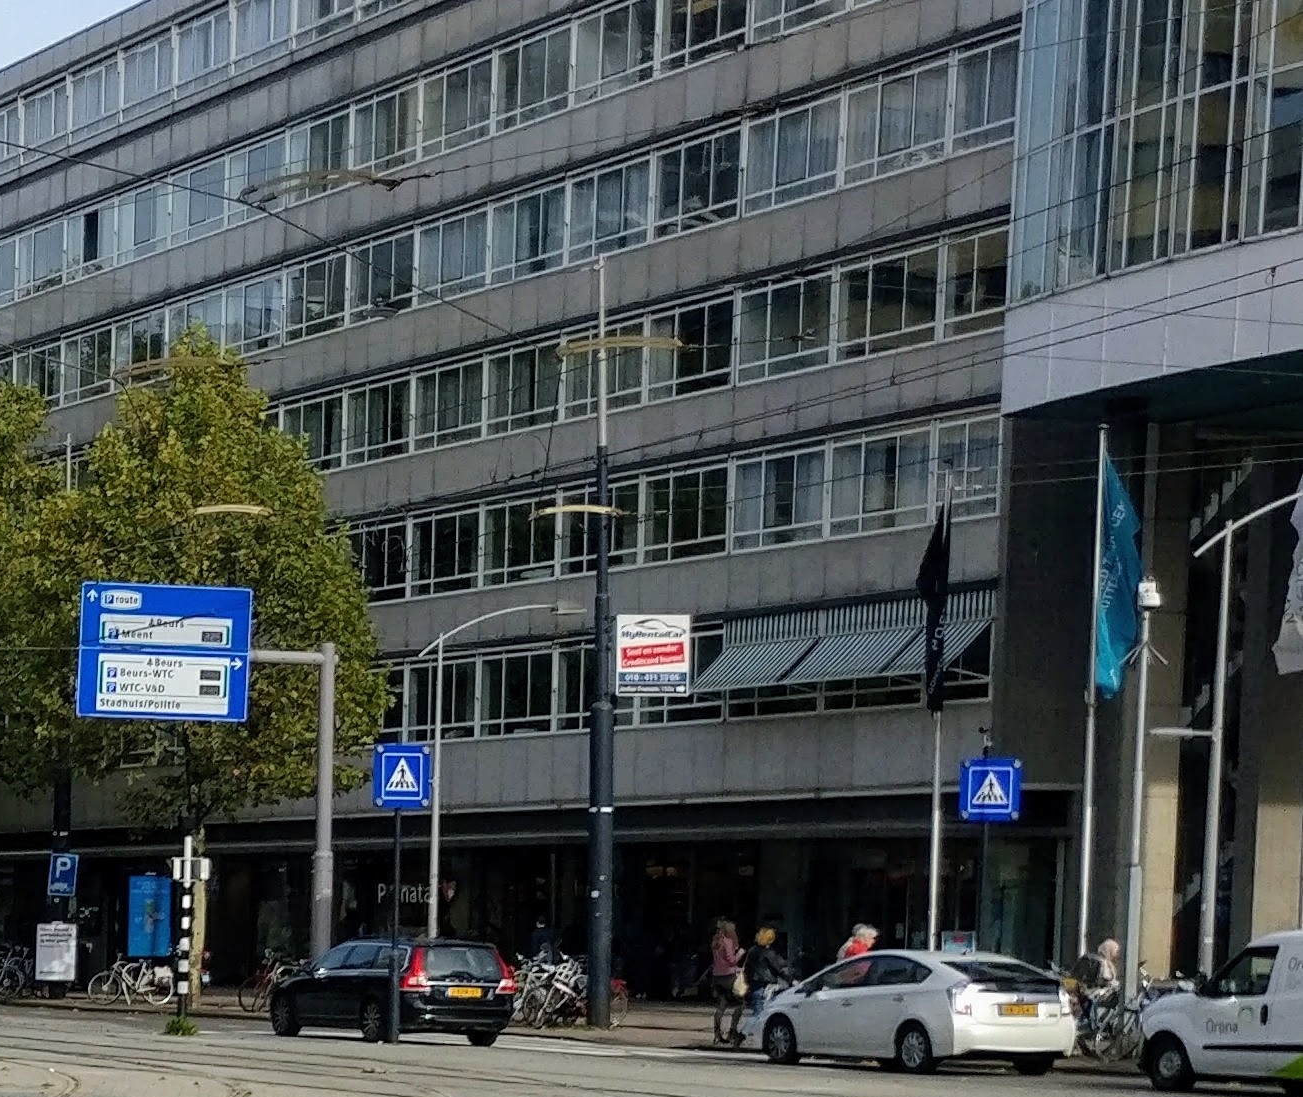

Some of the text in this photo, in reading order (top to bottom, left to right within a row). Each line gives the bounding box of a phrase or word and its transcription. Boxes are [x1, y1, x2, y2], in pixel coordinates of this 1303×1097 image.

[115, 596, 138, 604] route
[121, 629, 153, 639] Meent
[155, 657, 183, 667] Beurs
[120, 668, 174, 679] Beurs-WTC
[120, 683, 165, 693] WTC-V&D
[100, 698, 181, 709] Stadhuis/Politie
[56, 857, 71, 878] P
